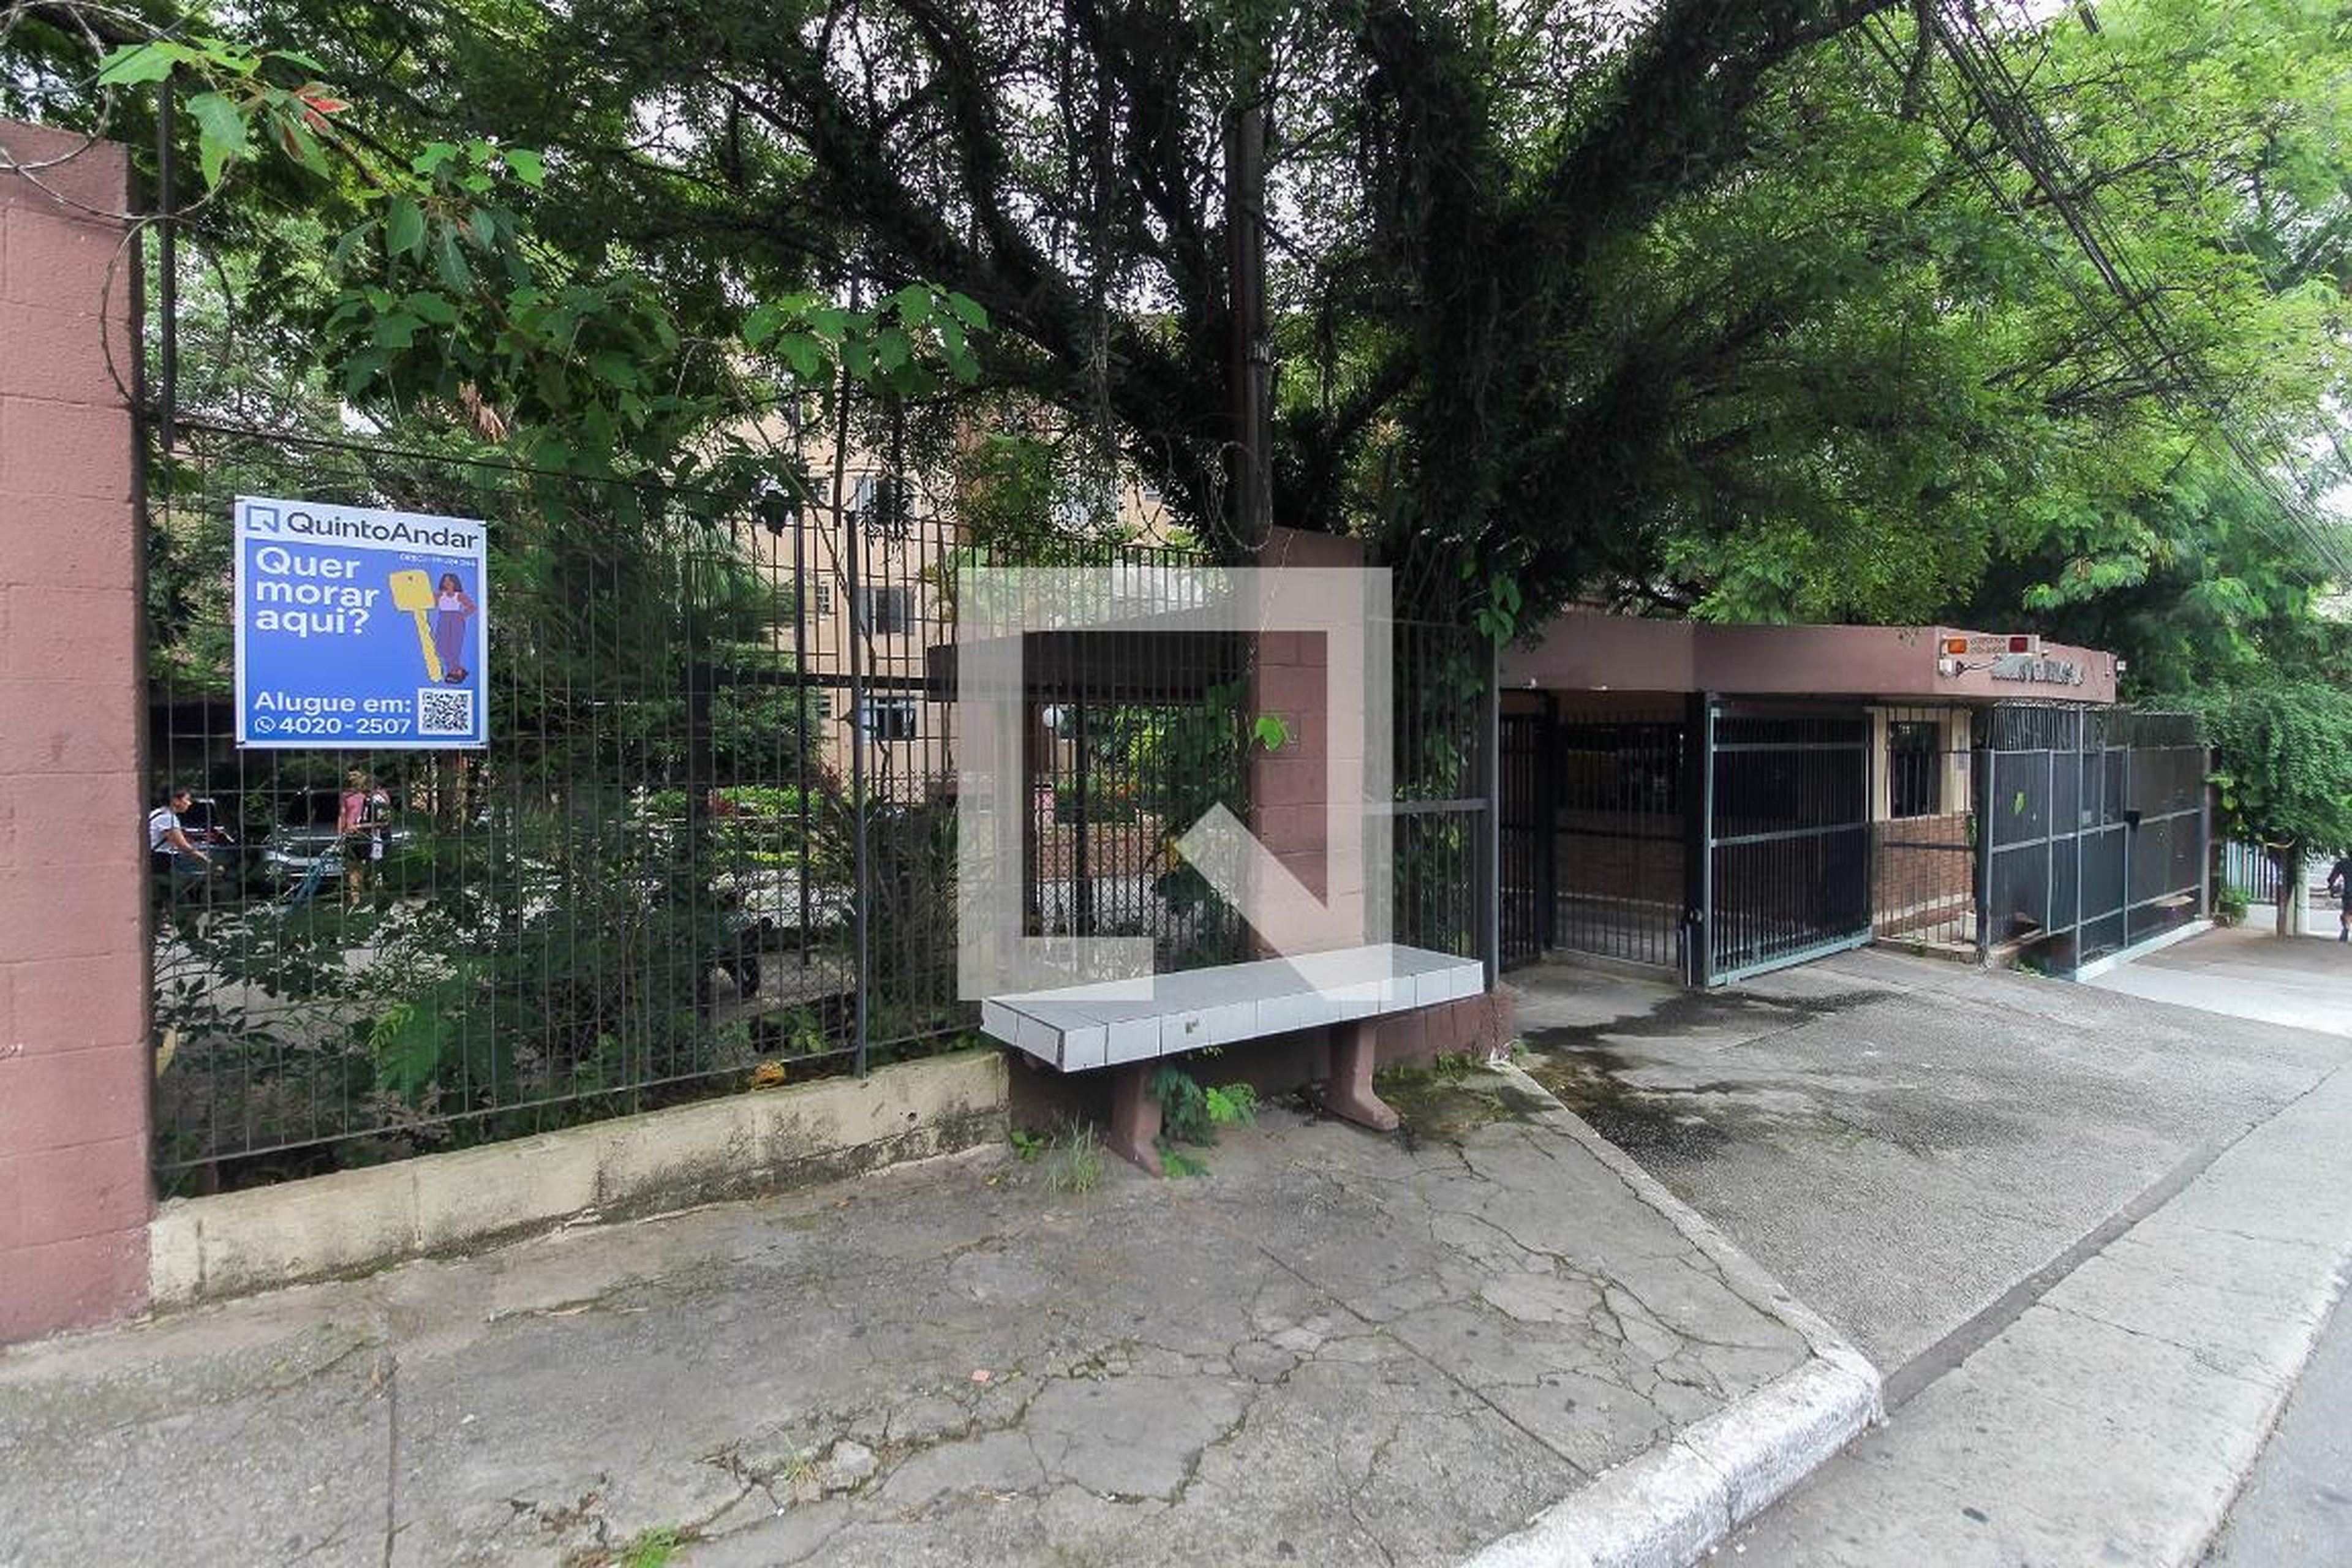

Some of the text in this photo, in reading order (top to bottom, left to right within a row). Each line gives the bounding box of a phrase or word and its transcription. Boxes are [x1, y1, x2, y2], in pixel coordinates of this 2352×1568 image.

[287, 511, 478, 549] QuintoAndar
[255, 546, 360, 579] Quer
[255, 580, 380, 608] morar
[255, 608, 371, 638] aqui?
[254, 692, 411, 715] Alugue em:
